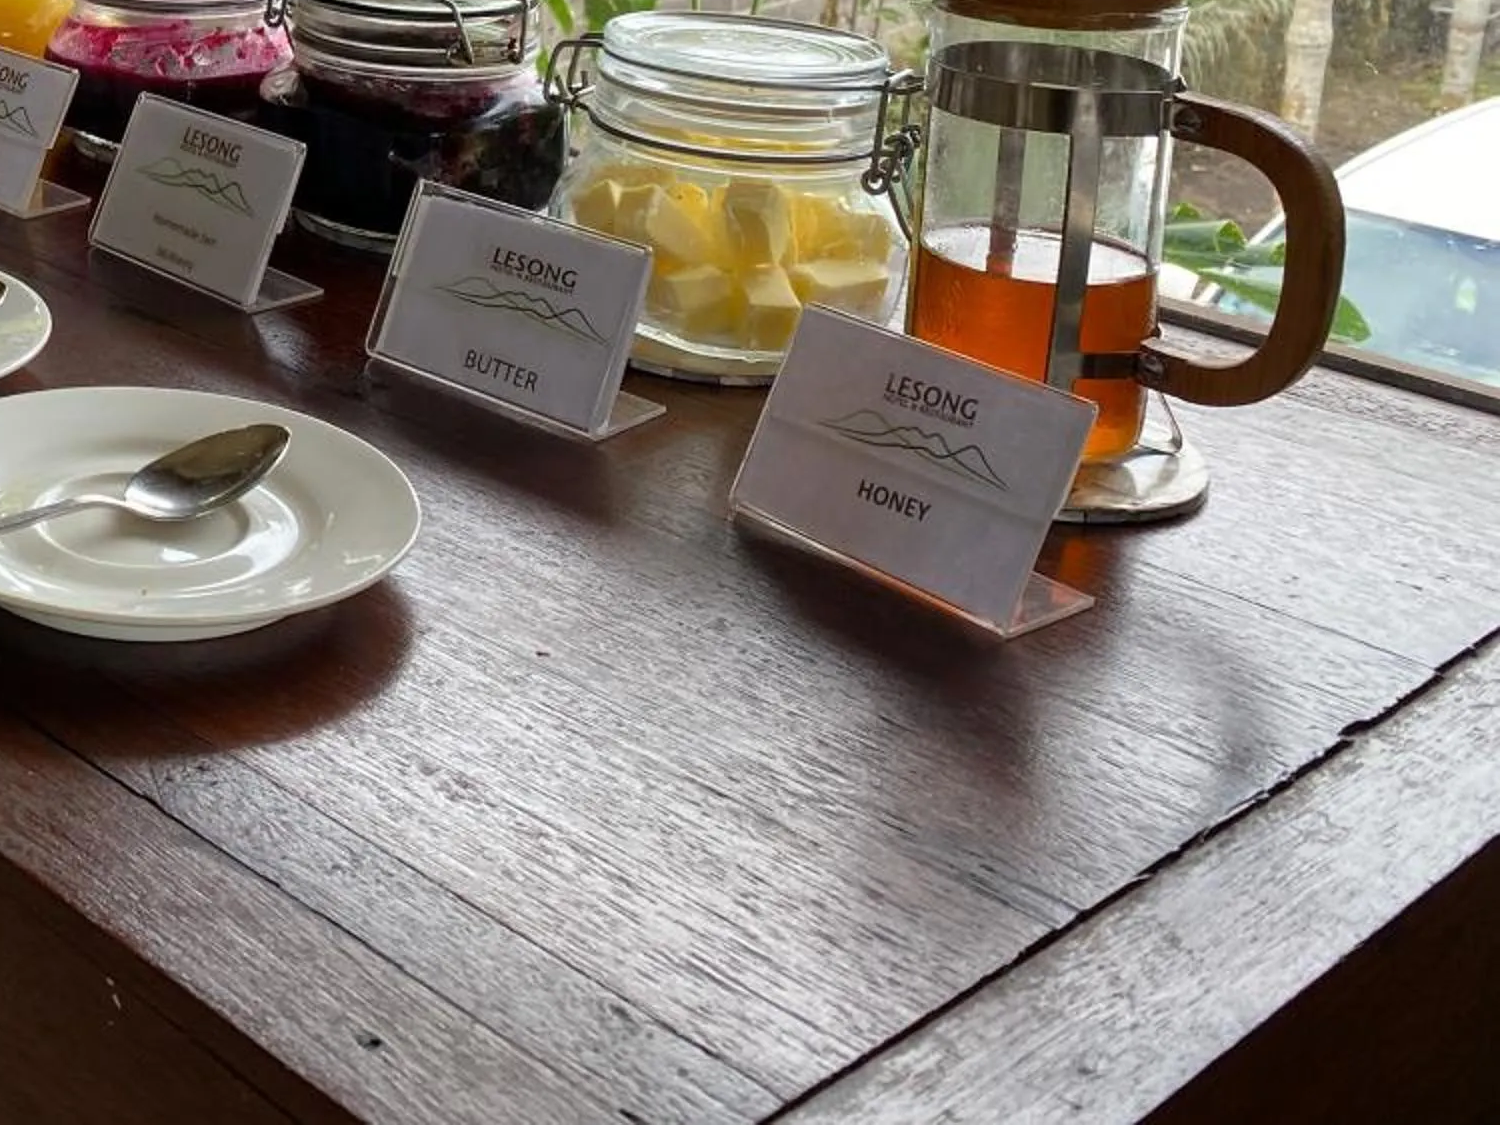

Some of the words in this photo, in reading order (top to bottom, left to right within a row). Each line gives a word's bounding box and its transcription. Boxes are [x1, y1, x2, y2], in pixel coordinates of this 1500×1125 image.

[183, 126, 244, 164] LESONG
[493, 246, 579, 289] LESONG
[463, 349, 539, 393] BUTTER
[885, 372, 979, 421] LESONG
[857, 478, 933, 523] HONEY
